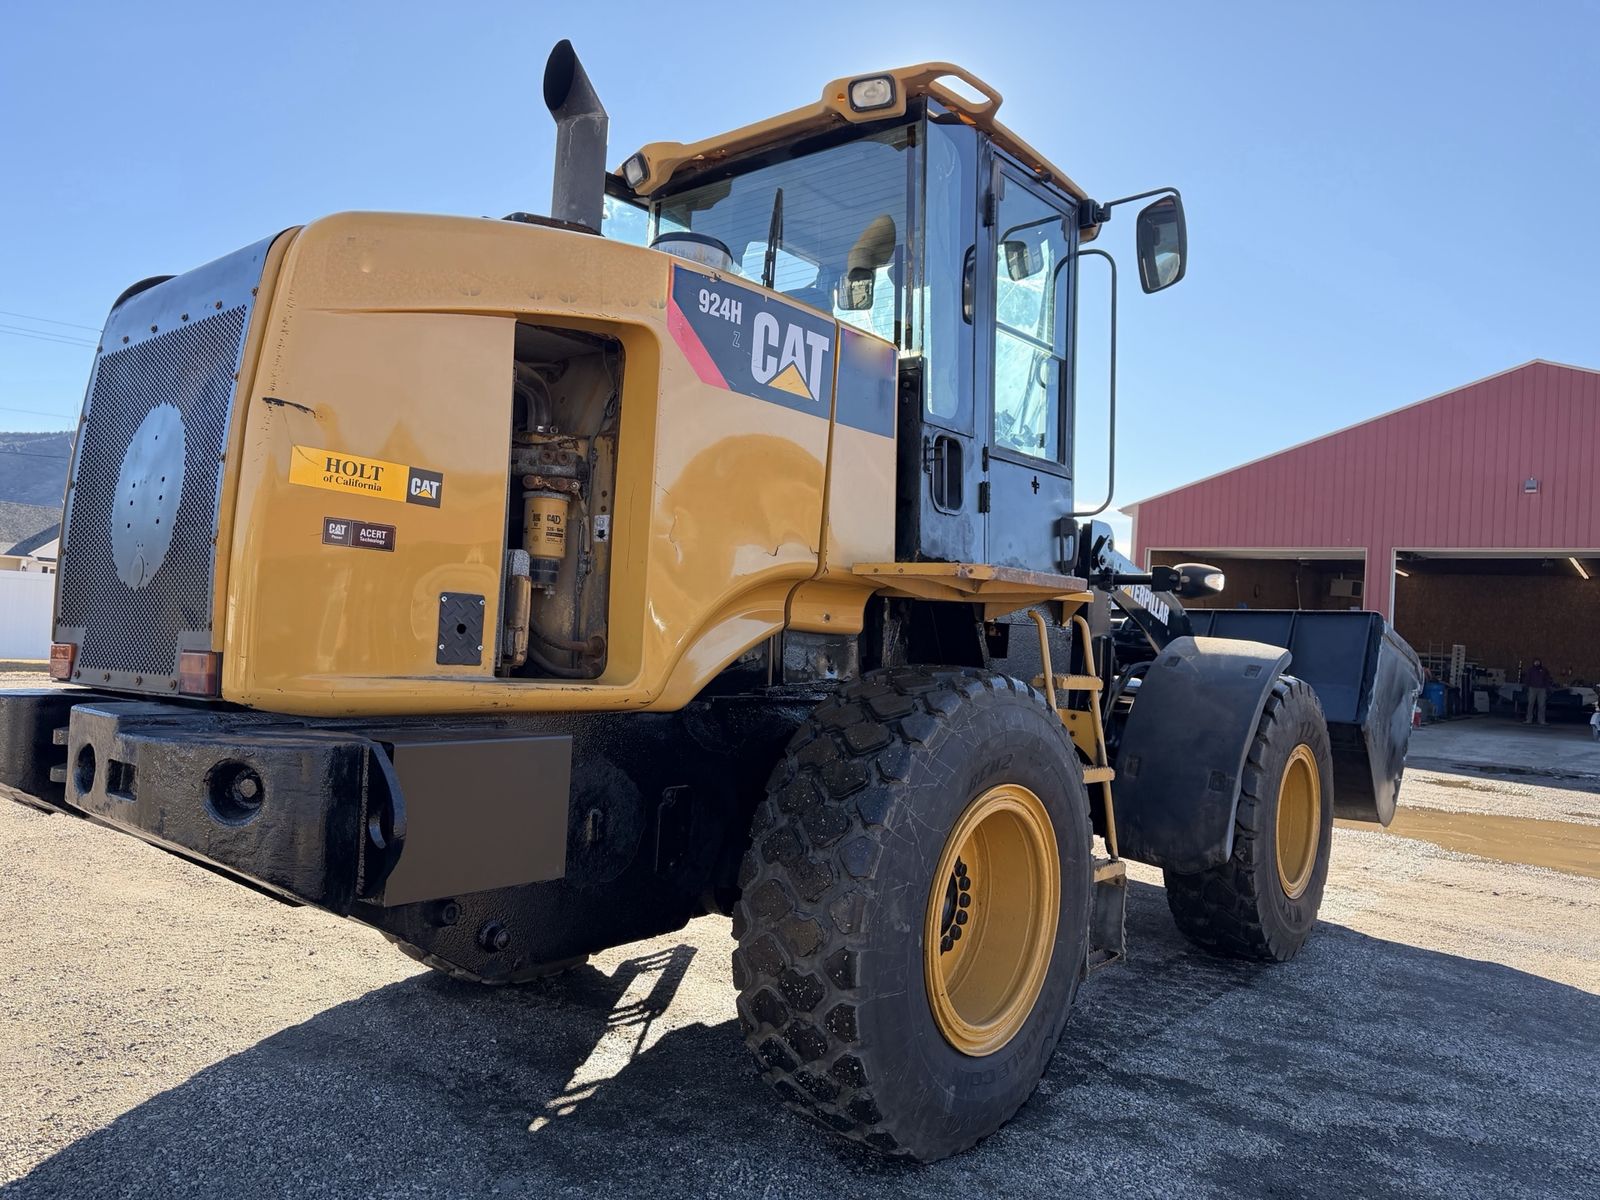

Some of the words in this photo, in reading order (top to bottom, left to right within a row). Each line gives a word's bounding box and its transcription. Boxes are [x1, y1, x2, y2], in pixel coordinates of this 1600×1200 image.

[699, 289, 742, 325] 924H
[752, 312, 829, 401] CAT
[325, 457, 384, 481] HOLT
[323, 475, 332, 483] of
[336, 476, 382, 492] California
[410, 478, 440, 499] CAT
[329, 523, 347, 535] CAT
[360, 528, 387, 539] ACERT
[360, 536, 385, 545] Technology
